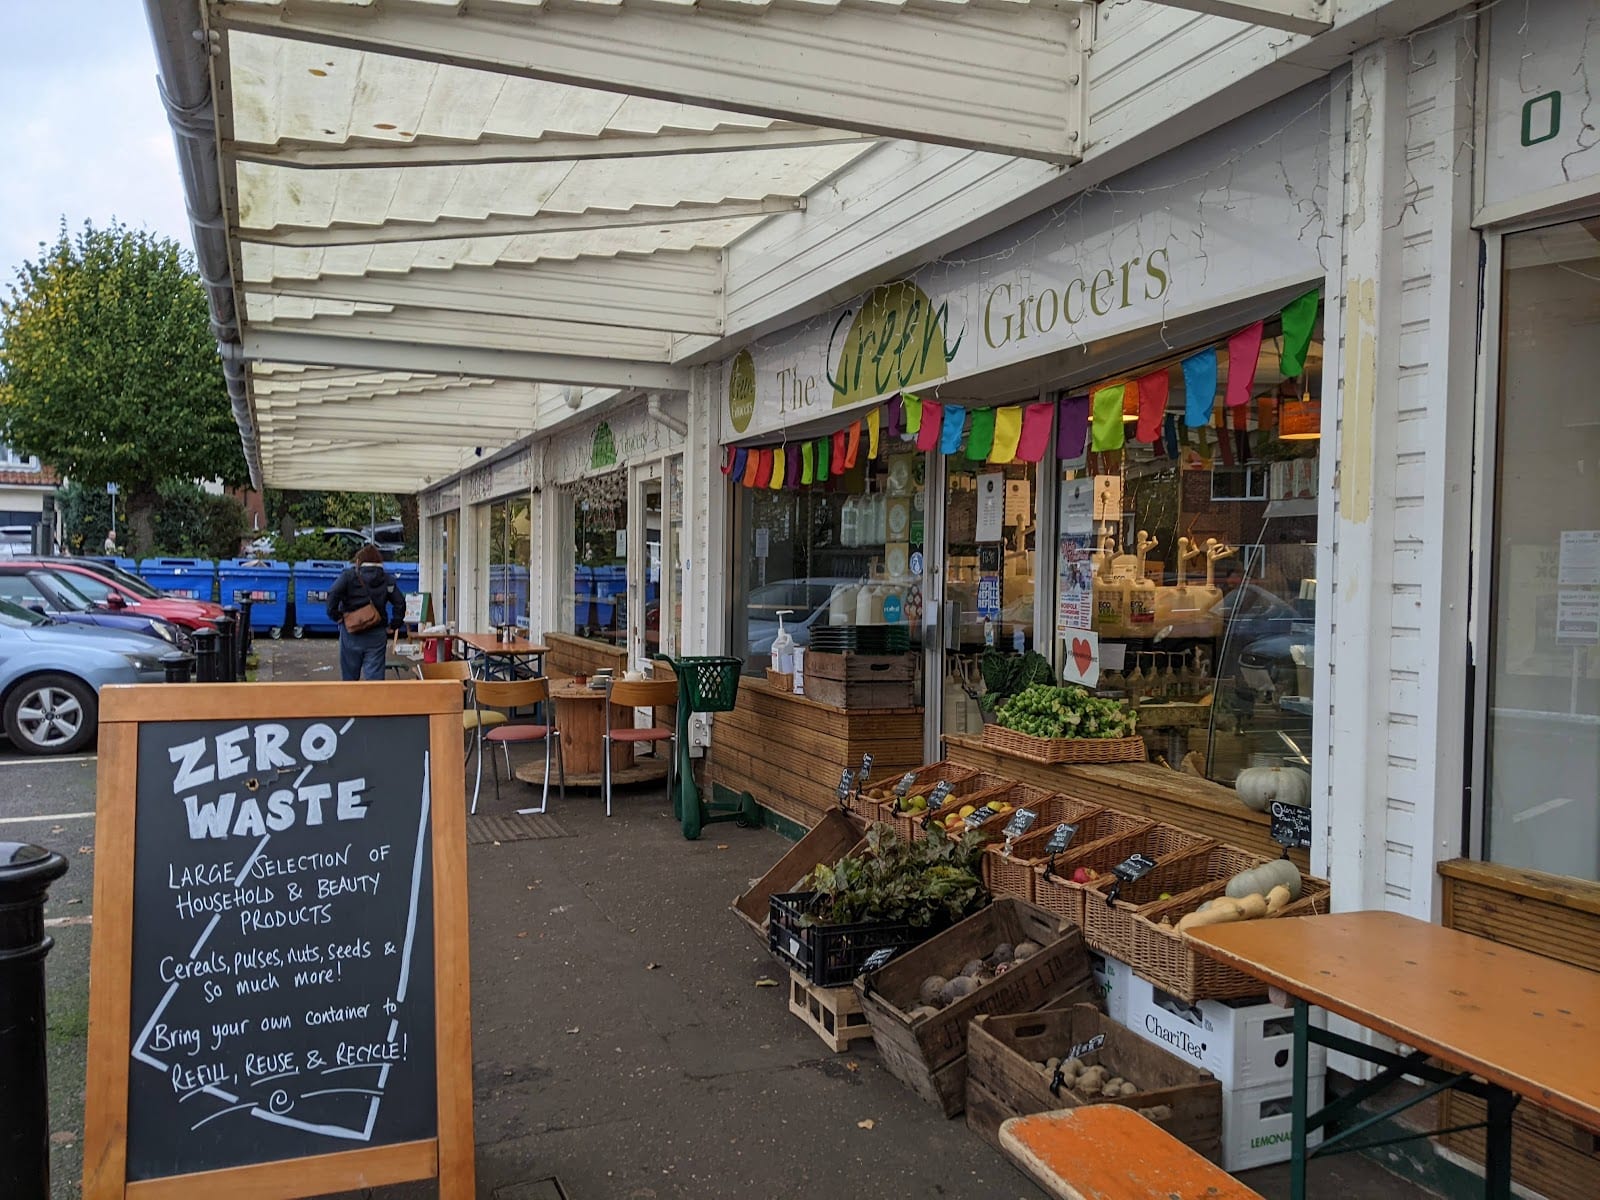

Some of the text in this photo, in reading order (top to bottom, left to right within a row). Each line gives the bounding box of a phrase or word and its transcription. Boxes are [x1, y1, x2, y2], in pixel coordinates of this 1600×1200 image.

[776, 247, 1170, 413] The Green Grocers
[168, 722, 338, 794] ZERO
[183, 778, 368, 840] WASTE
[168, 844, 391, 891] LARGE SELECTION OF
[175, 873, 381, 920] HOUSEHOLD & BEAUTY
[240, 903, 332, 935] PRODUCTS
[160, 937, 397, 983] Cereals, pulses, nuts, seeds &
[203, 960, 342, 1003] So much more!
[149, 996, 398, 1057] Bring your own container to
[1145, 1013, 1203, 1062] ChariTea
[172, 1032, 409, 1094] REFILL, REUSE, & RECYCLE!
